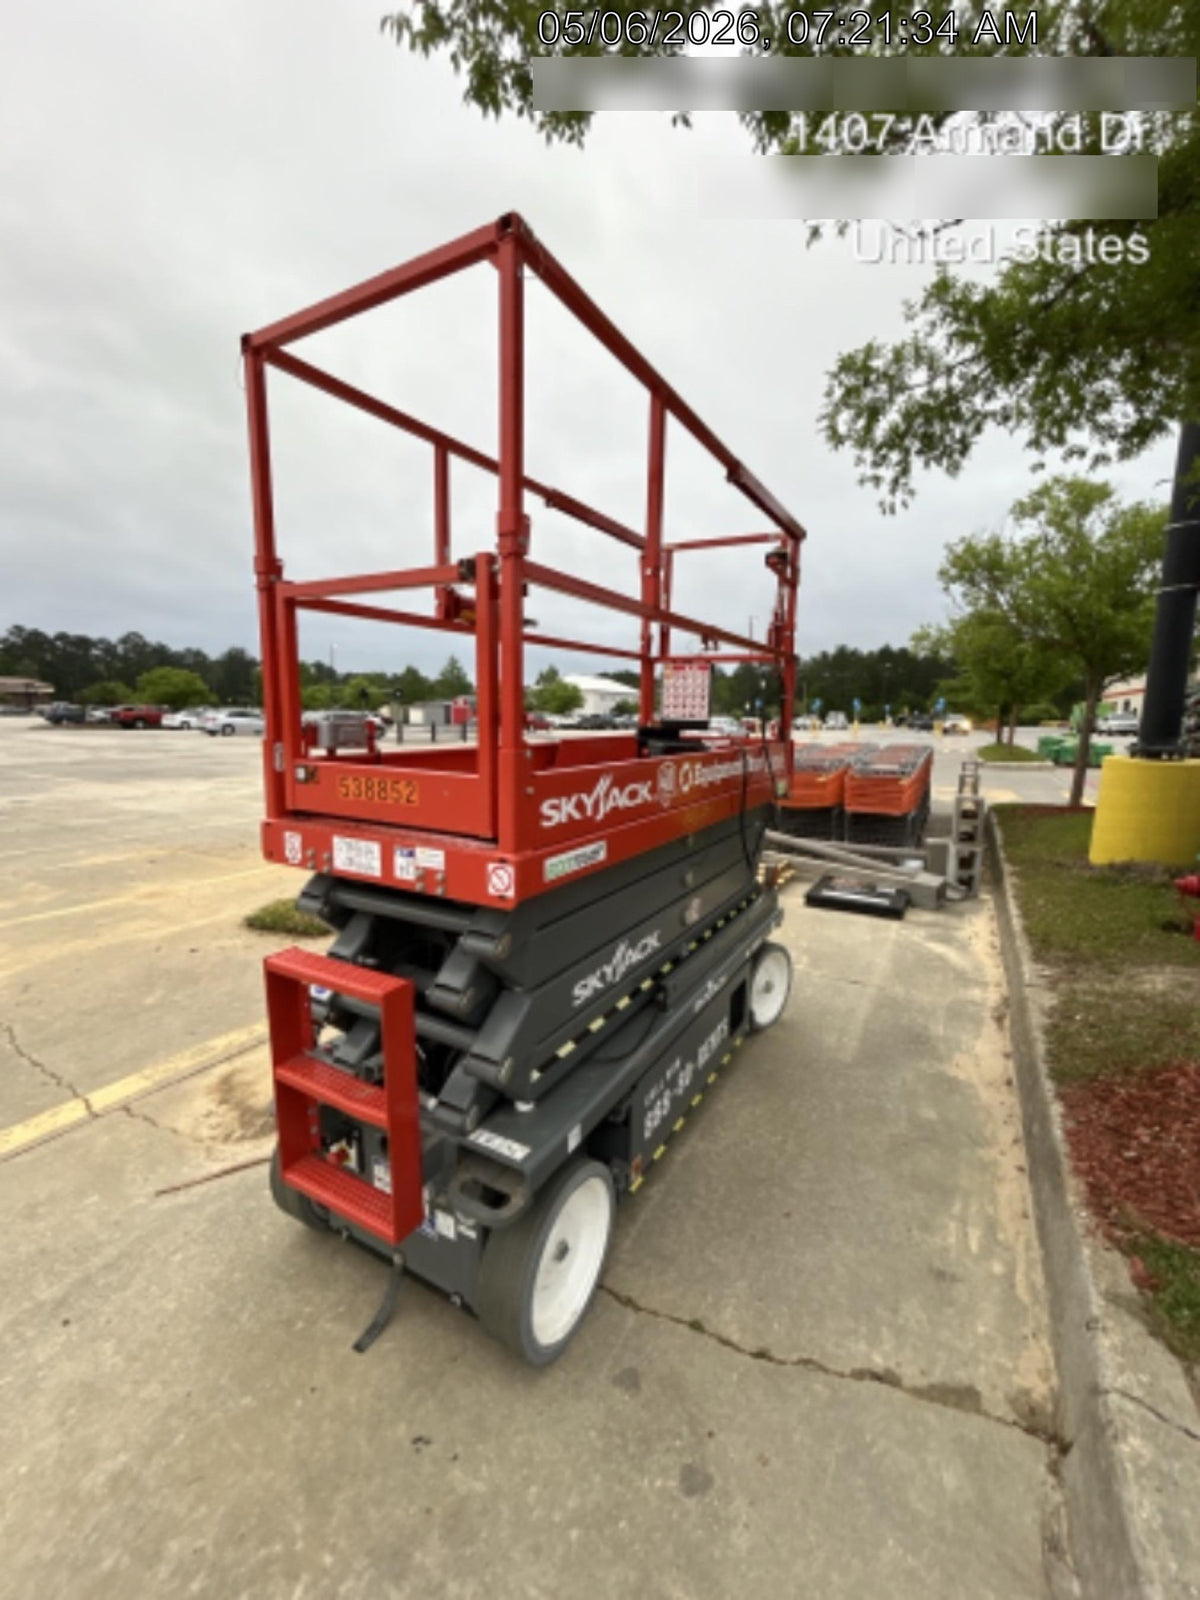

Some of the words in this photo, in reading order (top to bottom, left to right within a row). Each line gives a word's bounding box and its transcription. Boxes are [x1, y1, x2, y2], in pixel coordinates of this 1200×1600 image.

[338, 776, 419, 805] 538852
[540, 772, 655, 828] SKYJACK
[571, 930, 662, 1007] SKYJACK
